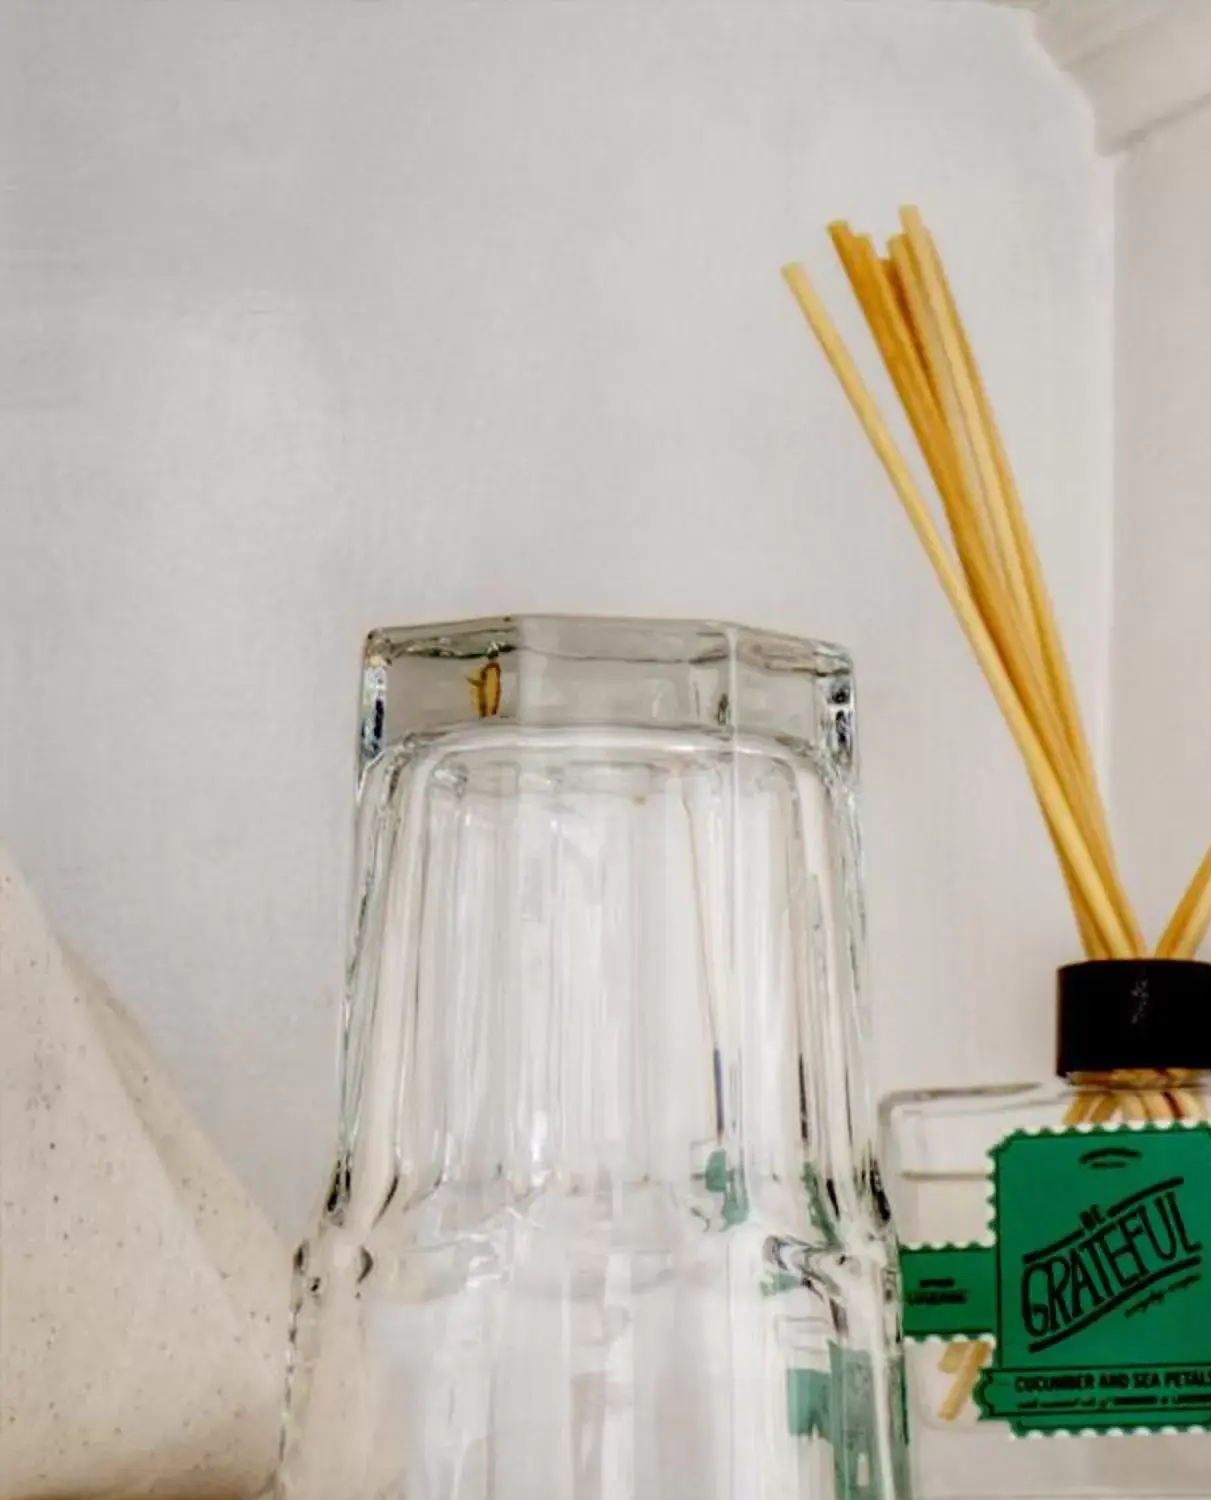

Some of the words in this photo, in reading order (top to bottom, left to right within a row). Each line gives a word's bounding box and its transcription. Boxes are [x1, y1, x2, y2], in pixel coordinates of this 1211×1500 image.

[1021, 1191, 1202, 1338] GRATEFUL
[1015, 1373, 1094, 1392] CUCUMBER
[1099, 1373, 1129, 1389] AND
[1133, 1372, 1161, 1388] SEA
